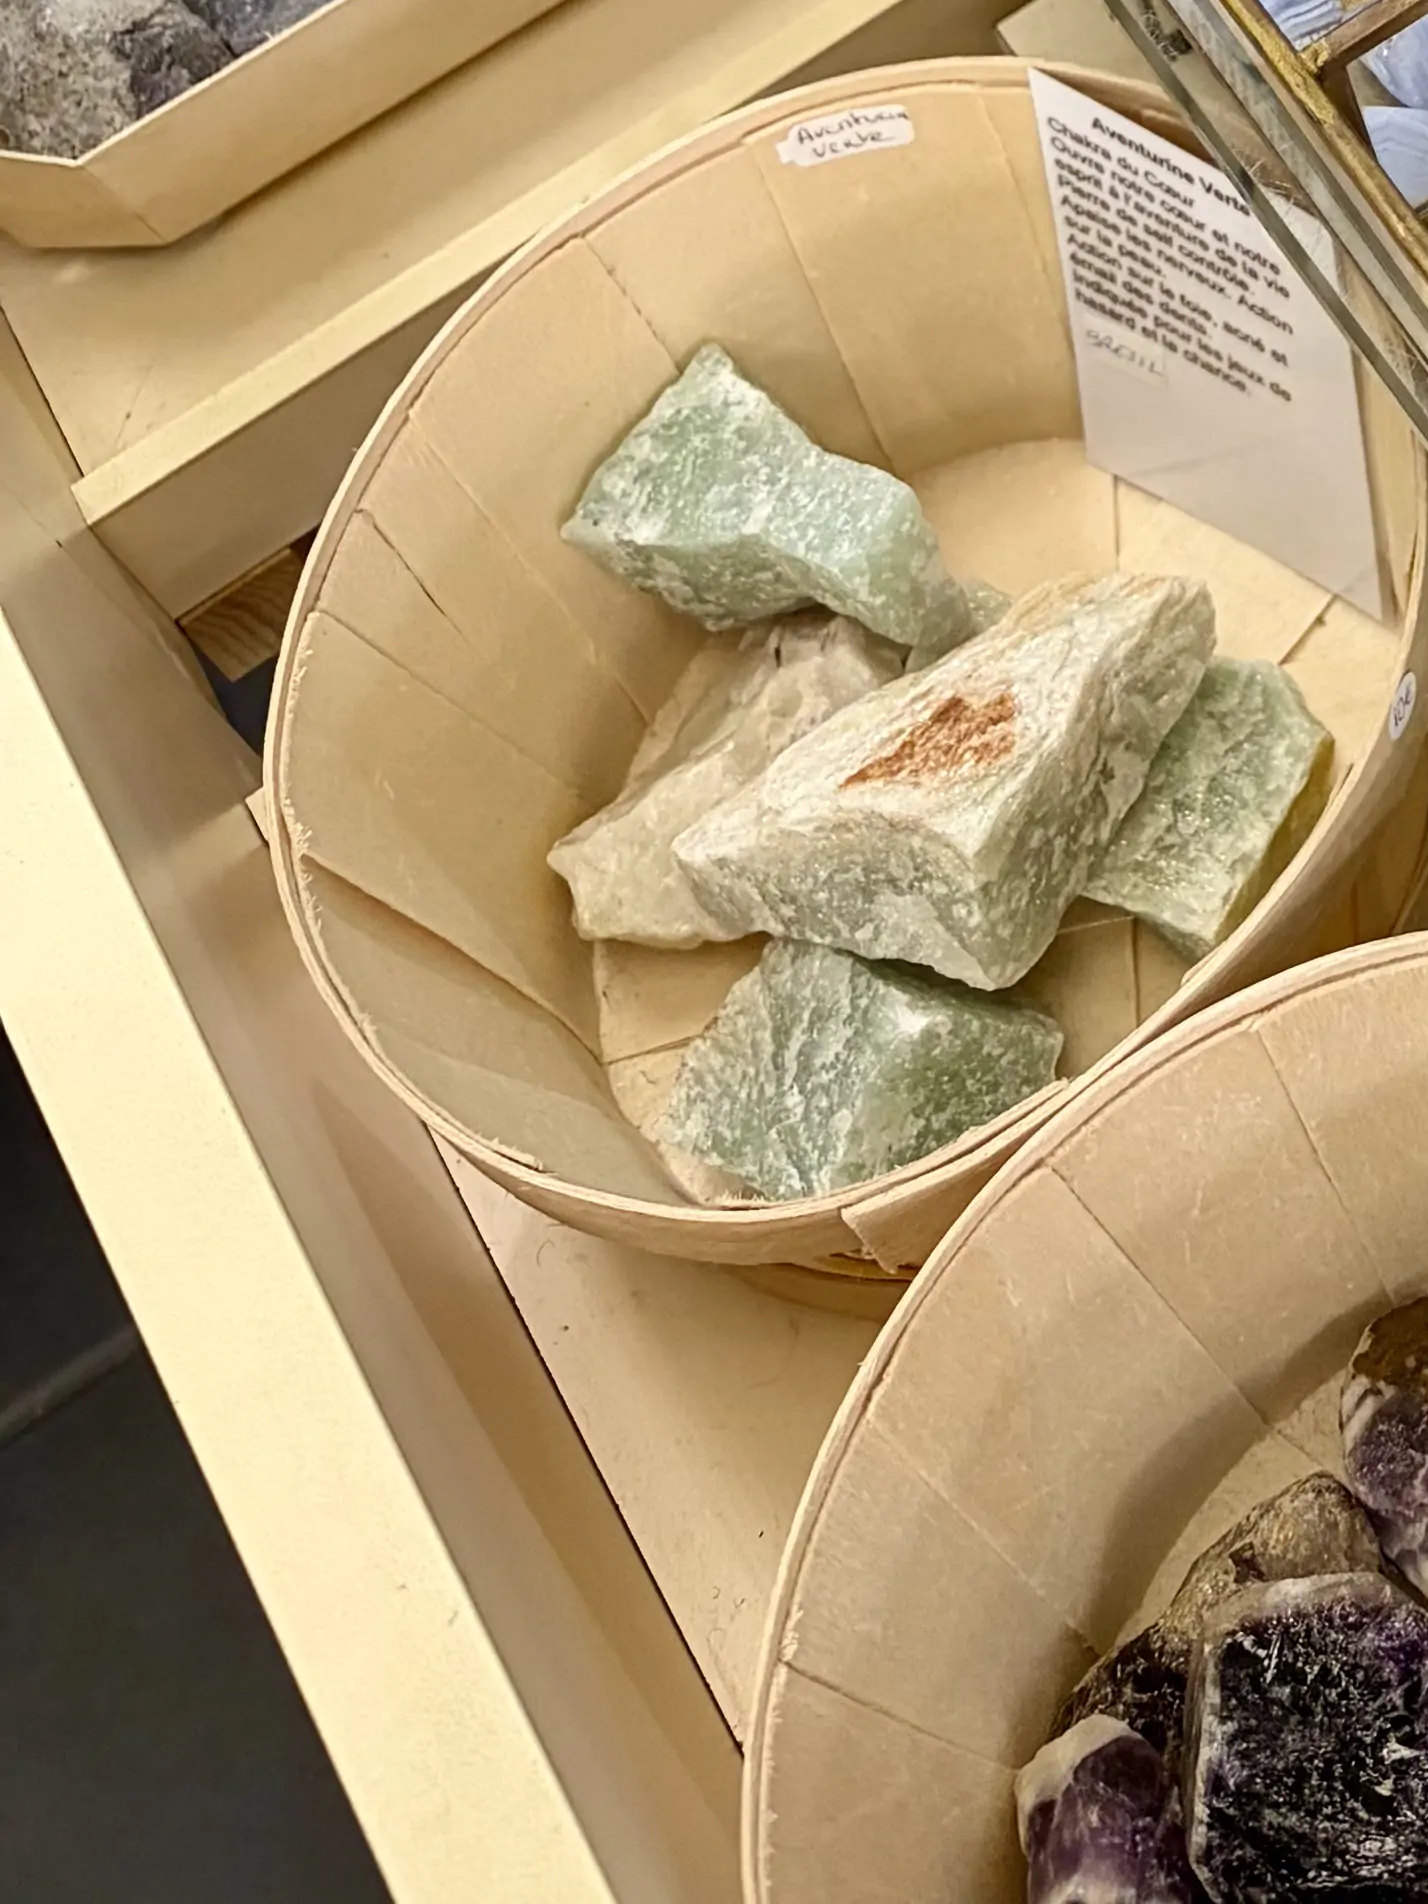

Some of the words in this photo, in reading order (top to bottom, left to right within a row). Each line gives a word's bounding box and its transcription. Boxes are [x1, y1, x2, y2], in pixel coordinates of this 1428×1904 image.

[1047, 117, 1112, 162] Chakra
[1116, 157, 1140, 177] du
[1091, 117, 1195, 185] Aventurine
